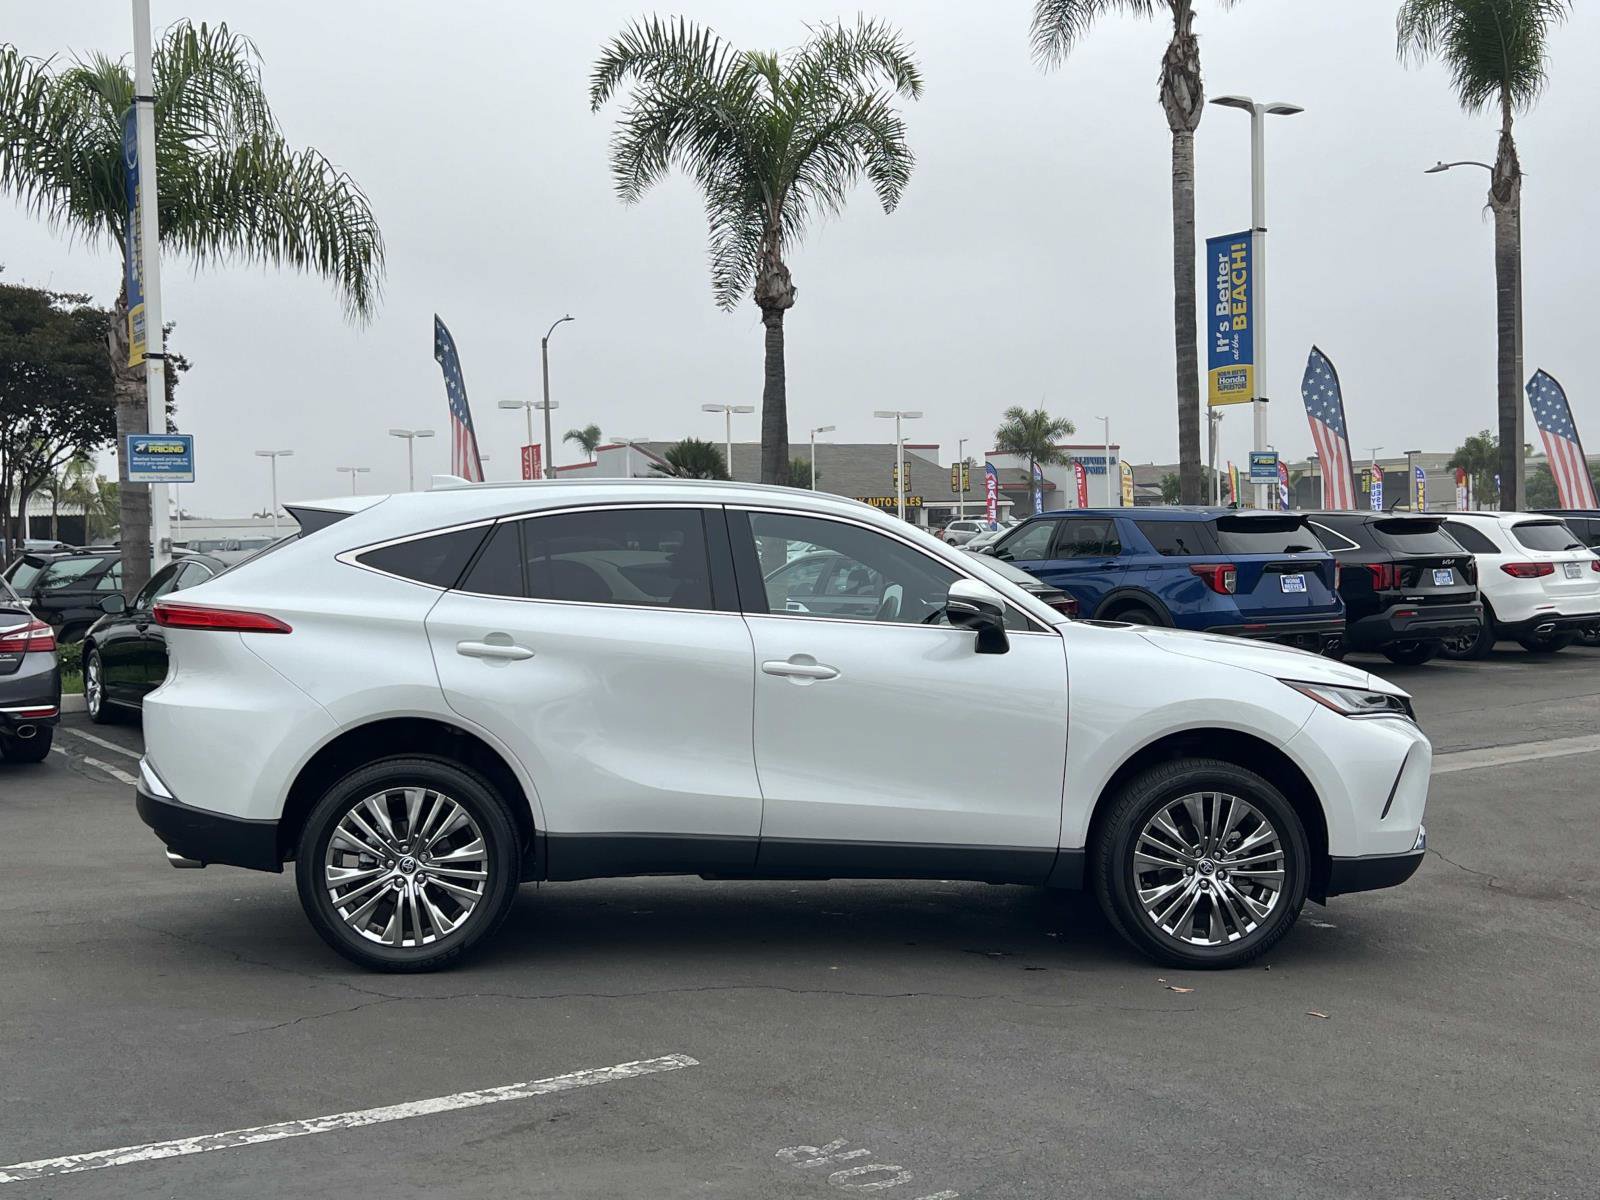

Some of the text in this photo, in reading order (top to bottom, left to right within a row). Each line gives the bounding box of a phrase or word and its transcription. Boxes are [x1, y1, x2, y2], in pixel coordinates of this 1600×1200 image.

[1216, 253, 1230, 353] It's Better
[1231, 243, 1247, 360] at the BEACH!
[1219, 376, 1246, 384] Honda
[868, 497, 892, 506] AUTO
[893, 496, 921, 506] SLES
